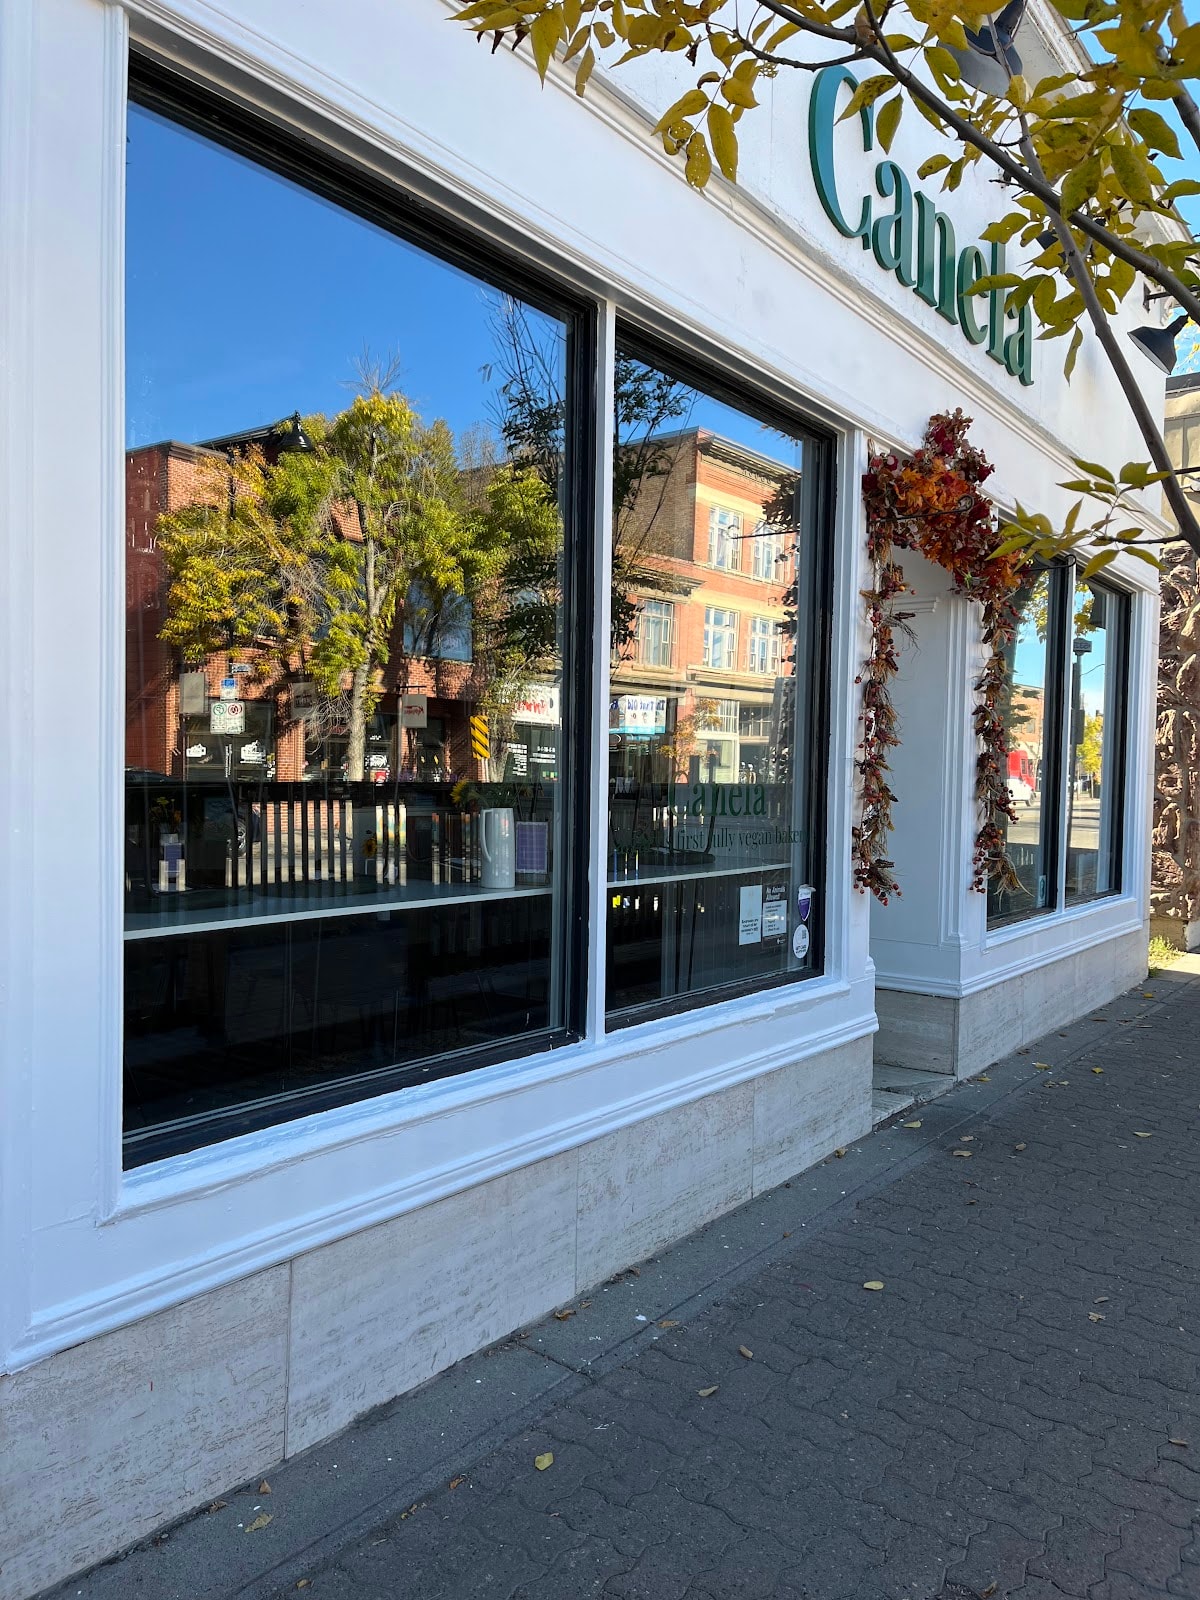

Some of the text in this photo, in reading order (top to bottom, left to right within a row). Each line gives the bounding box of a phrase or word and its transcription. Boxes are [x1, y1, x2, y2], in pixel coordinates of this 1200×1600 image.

[808, 65, 1034, 387] Canela
[668, 770, 767, 817] Canela
[677, 829, 705, 850] first
[739, 830, 772, 850] vegan
